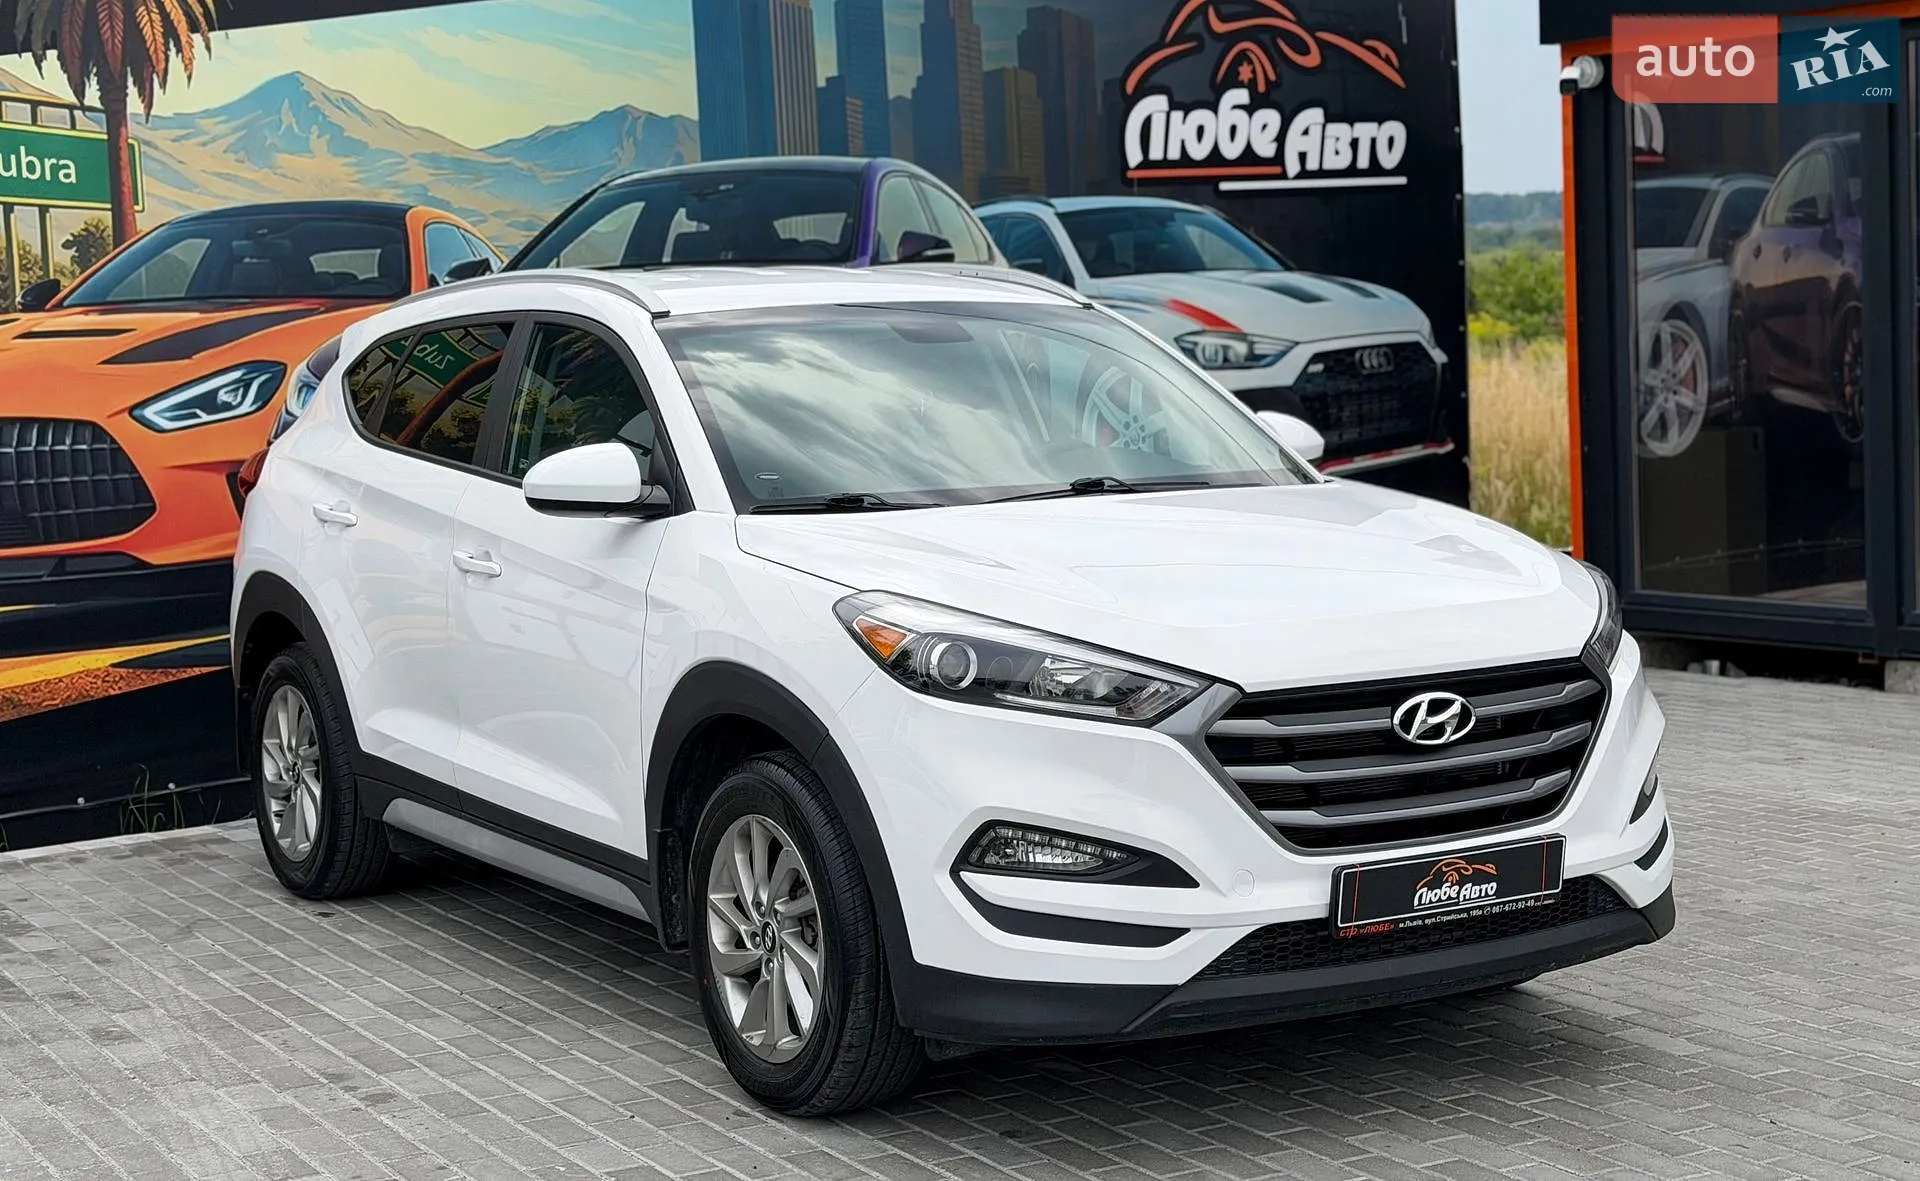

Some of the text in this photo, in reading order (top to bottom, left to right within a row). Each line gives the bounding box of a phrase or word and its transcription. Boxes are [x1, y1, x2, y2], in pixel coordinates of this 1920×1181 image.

[1124, 88, 1407, 179] Любе Авто
[1414, 882, 1497, 907] Любе Авто
